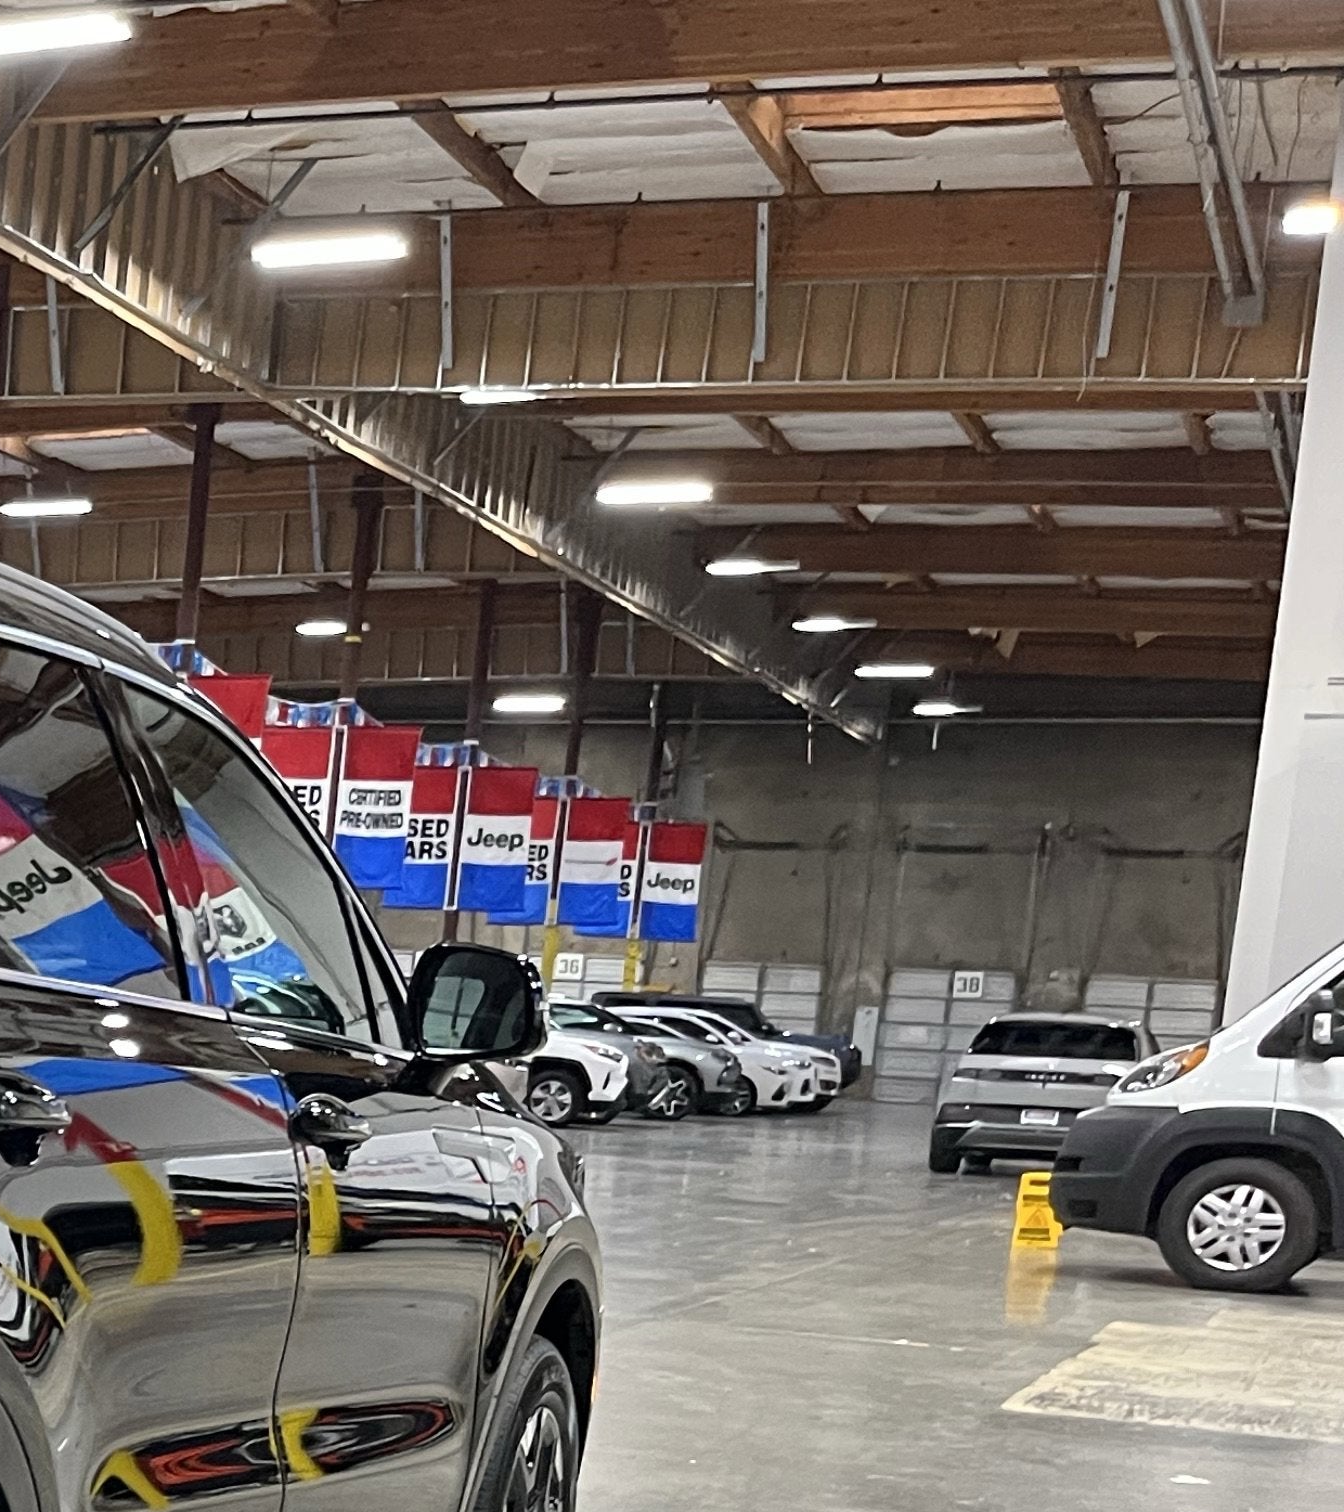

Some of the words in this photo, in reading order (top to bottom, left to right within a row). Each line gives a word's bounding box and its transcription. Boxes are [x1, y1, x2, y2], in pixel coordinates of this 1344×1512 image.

[293, 785, 322, 806] ED
[339, 810, 404, 829] PRE-OWNED
[407, 818, 450, 838] SED
[405, 840, 448, 860] ARS
[467, 828, 525, 852] Jeep
[527, 844, 549, 862] ED
[525, 863, 548, 881] RS
[646, 872, 696, 894] Jeep
[558, 958, 580, 974] 36
